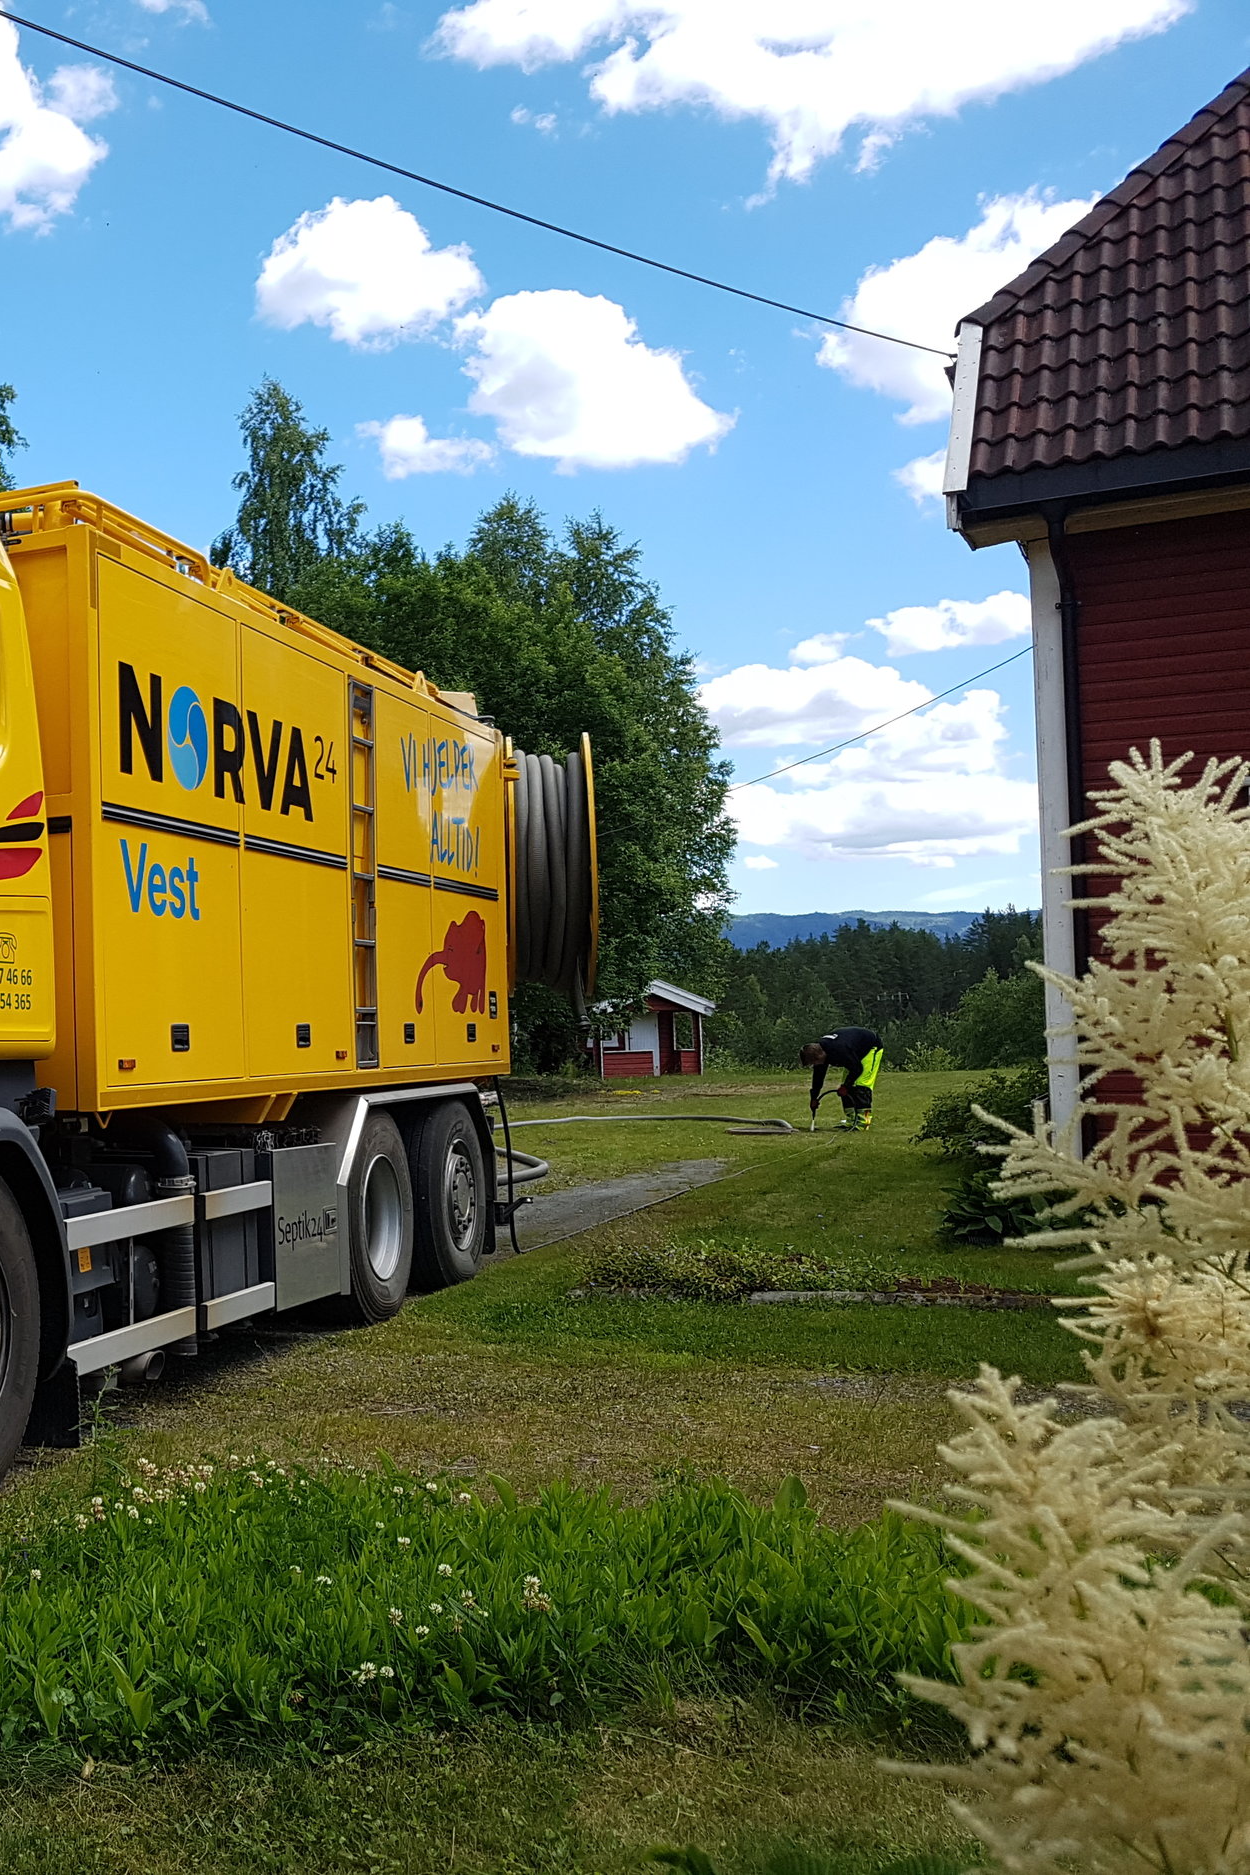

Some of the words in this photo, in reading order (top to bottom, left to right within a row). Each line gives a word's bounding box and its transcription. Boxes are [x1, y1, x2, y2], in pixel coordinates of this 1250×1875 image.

[400, 732, 417, 793] VI
[422, 737, 479, 796] HJELPER
[119, 838, 200, 921] Vest
[6, 968, 19, 985] 46
[21, 969, 32, 986] 66
[0, 993, 12, 1009] 54
[14, 993, 32, 1010] 365
[278, 1210, 323, 1251] Septik24
